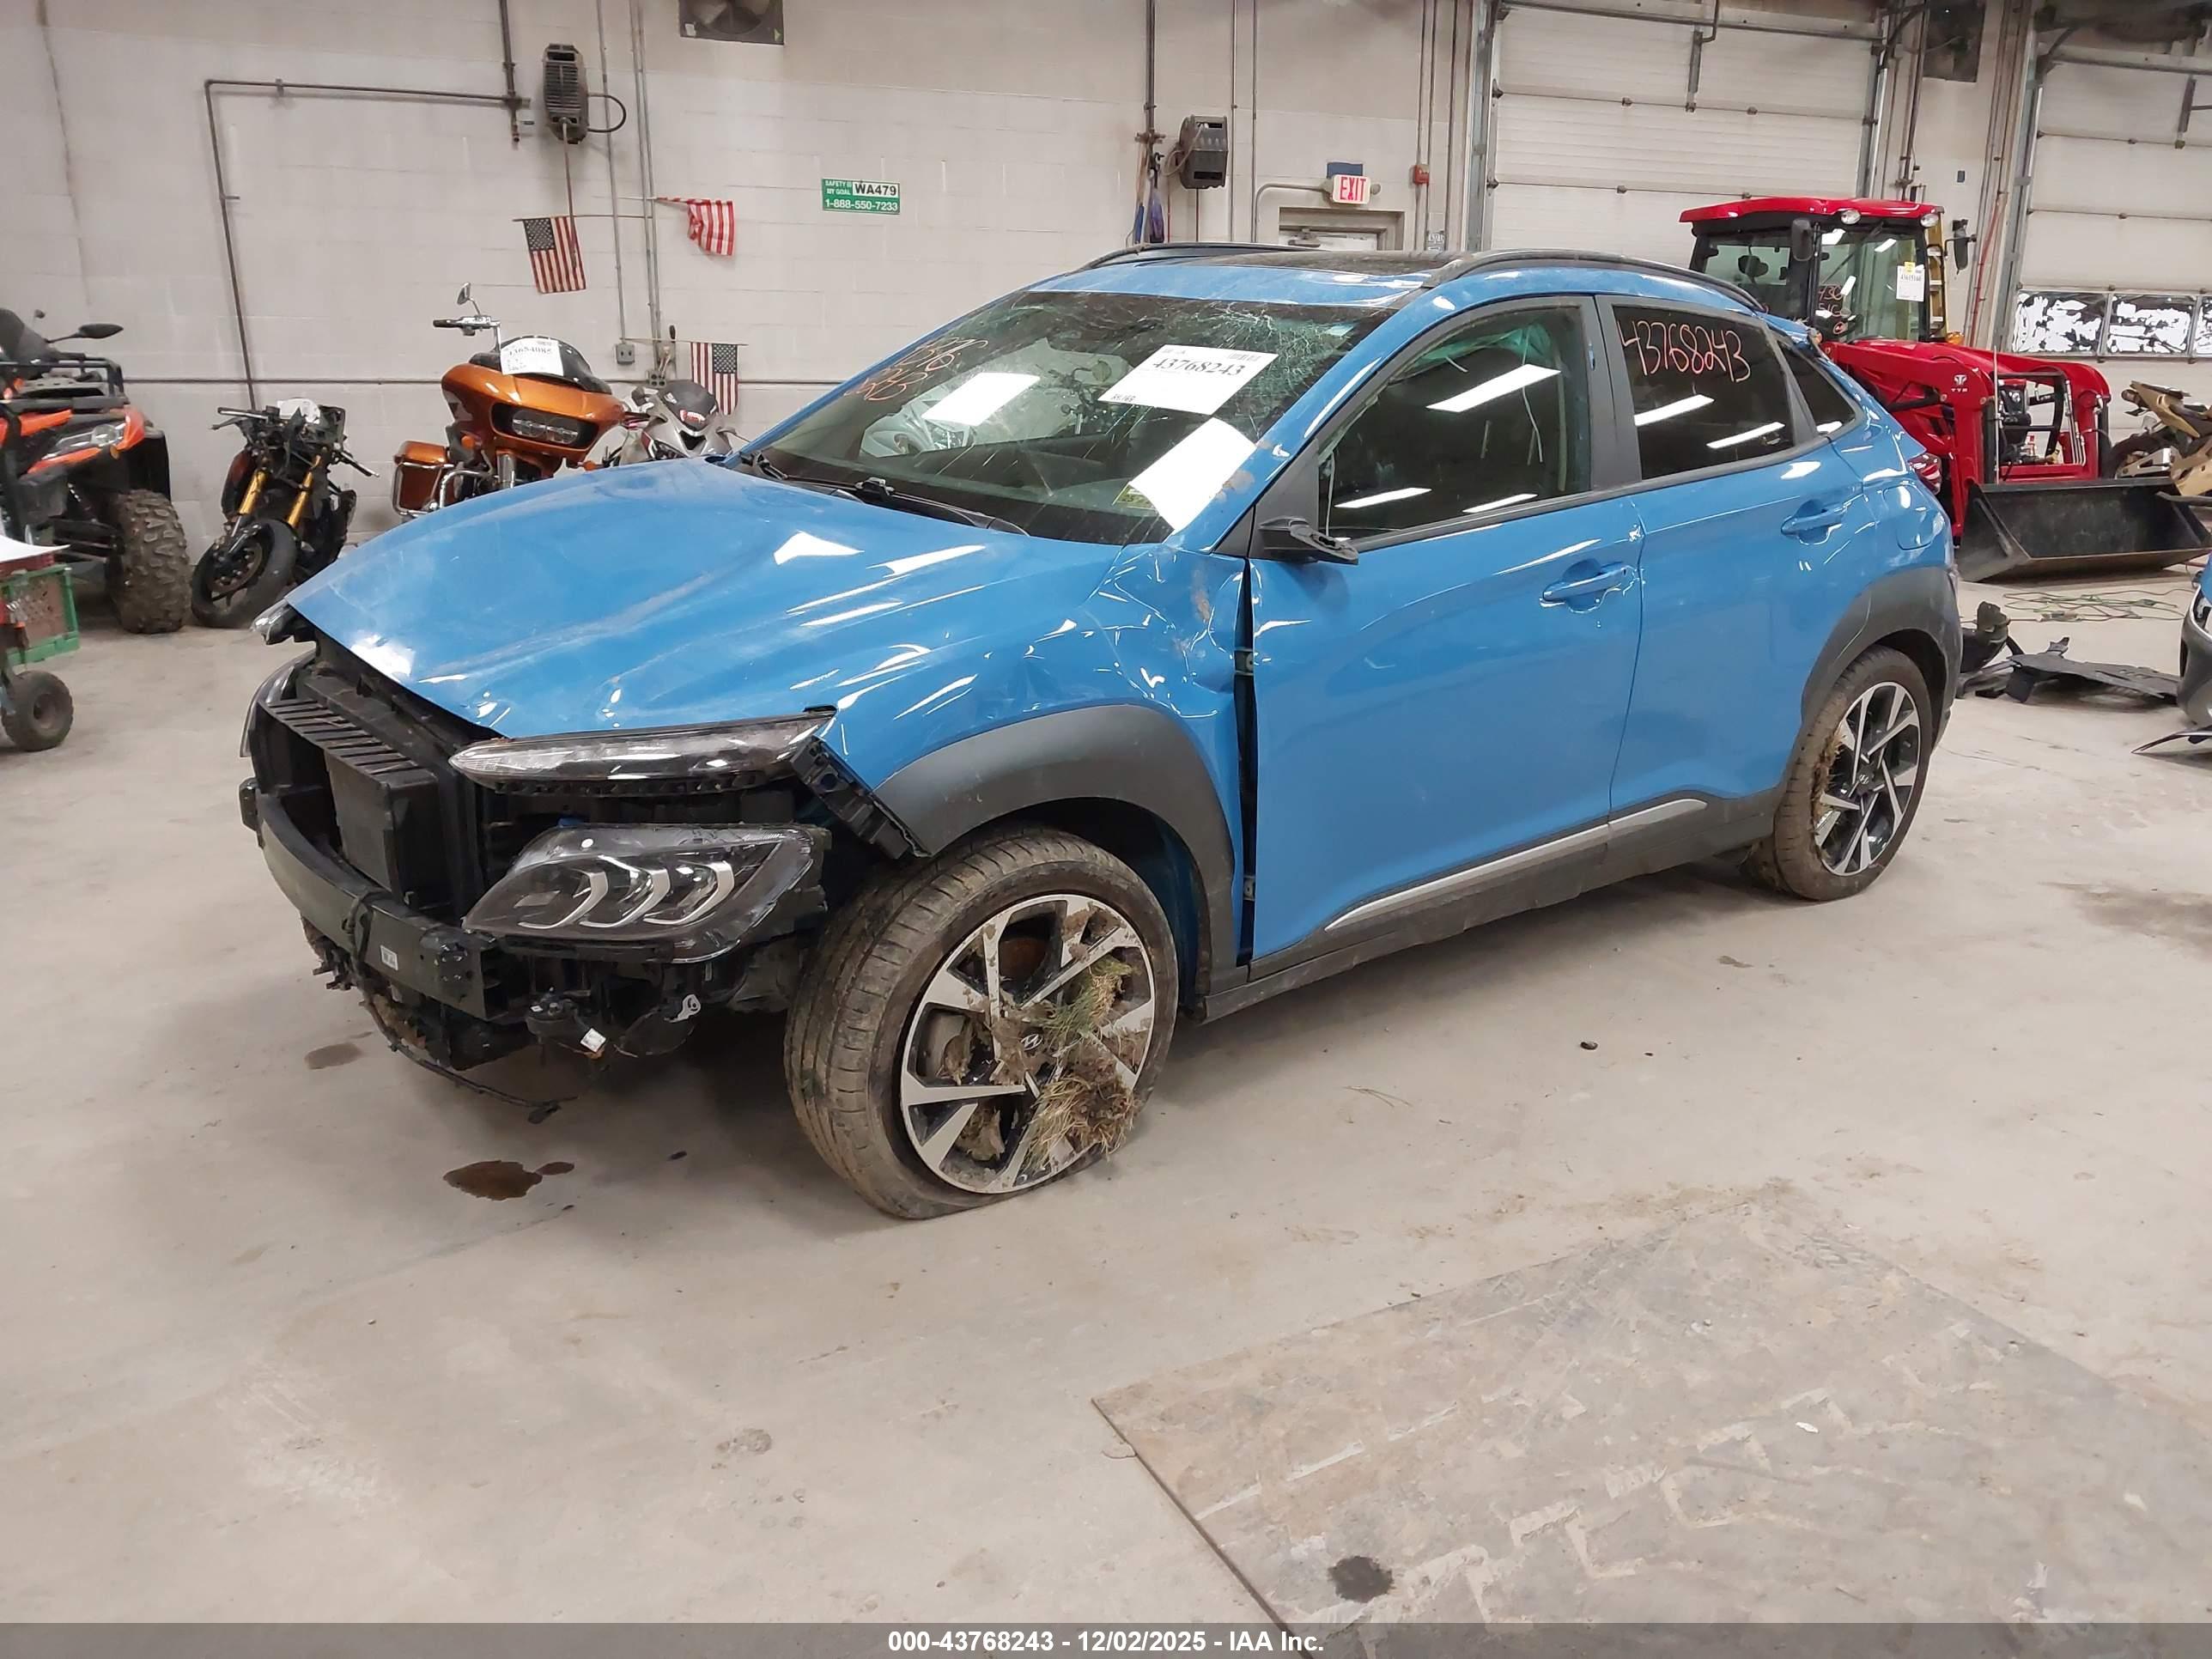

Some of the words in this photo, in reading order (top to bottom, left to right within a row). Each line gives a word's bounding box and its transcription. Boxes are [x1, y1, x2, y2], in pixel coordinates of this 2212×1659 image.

[854, 183, 897, 196] WA479
[1340, 176, 1366, 202] EXIT
[824, 198, 898, 211] 1-888-550-7233
[1617, 320, 1751, 382] 43768243
[1152, 358, 1246, 376] 43768243
